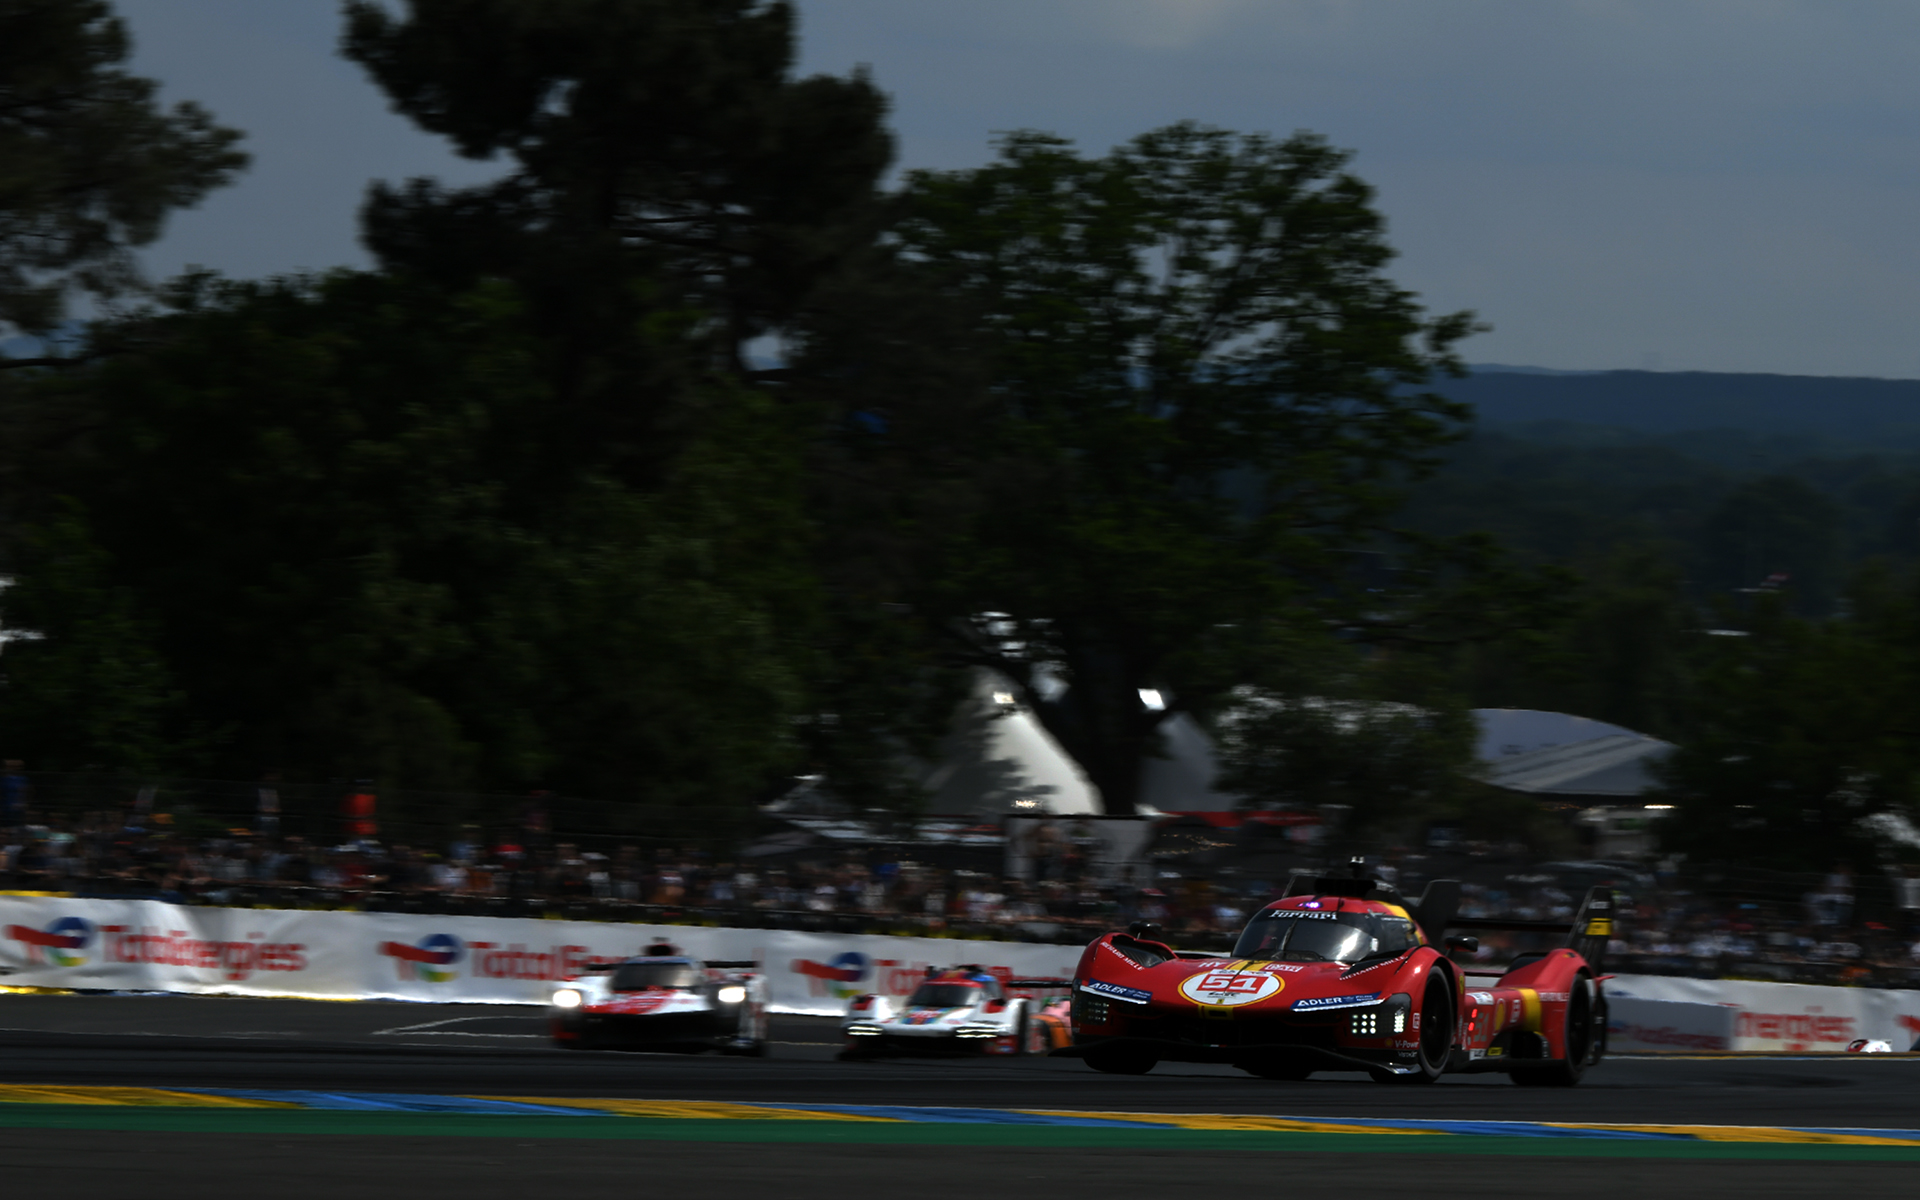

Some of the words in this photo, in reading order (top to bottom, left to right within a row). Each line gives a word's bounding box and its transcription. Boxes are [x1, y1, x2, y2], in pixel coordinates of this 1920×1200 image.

[1268, 909, 1338, 921] Ferrari
[1123, 957, 1145, 971] MILLE
[1339, 965, 1378, 981] RICHARD
[1380, 956, 1408, 967] MILLE
[1089, 982, 1127, 994] ADLER
[1201, 975, 1258, 991] 51
[1297, 996, 1342, 1007] ADLER
[1473, 1012, 1490, 1042] 51
